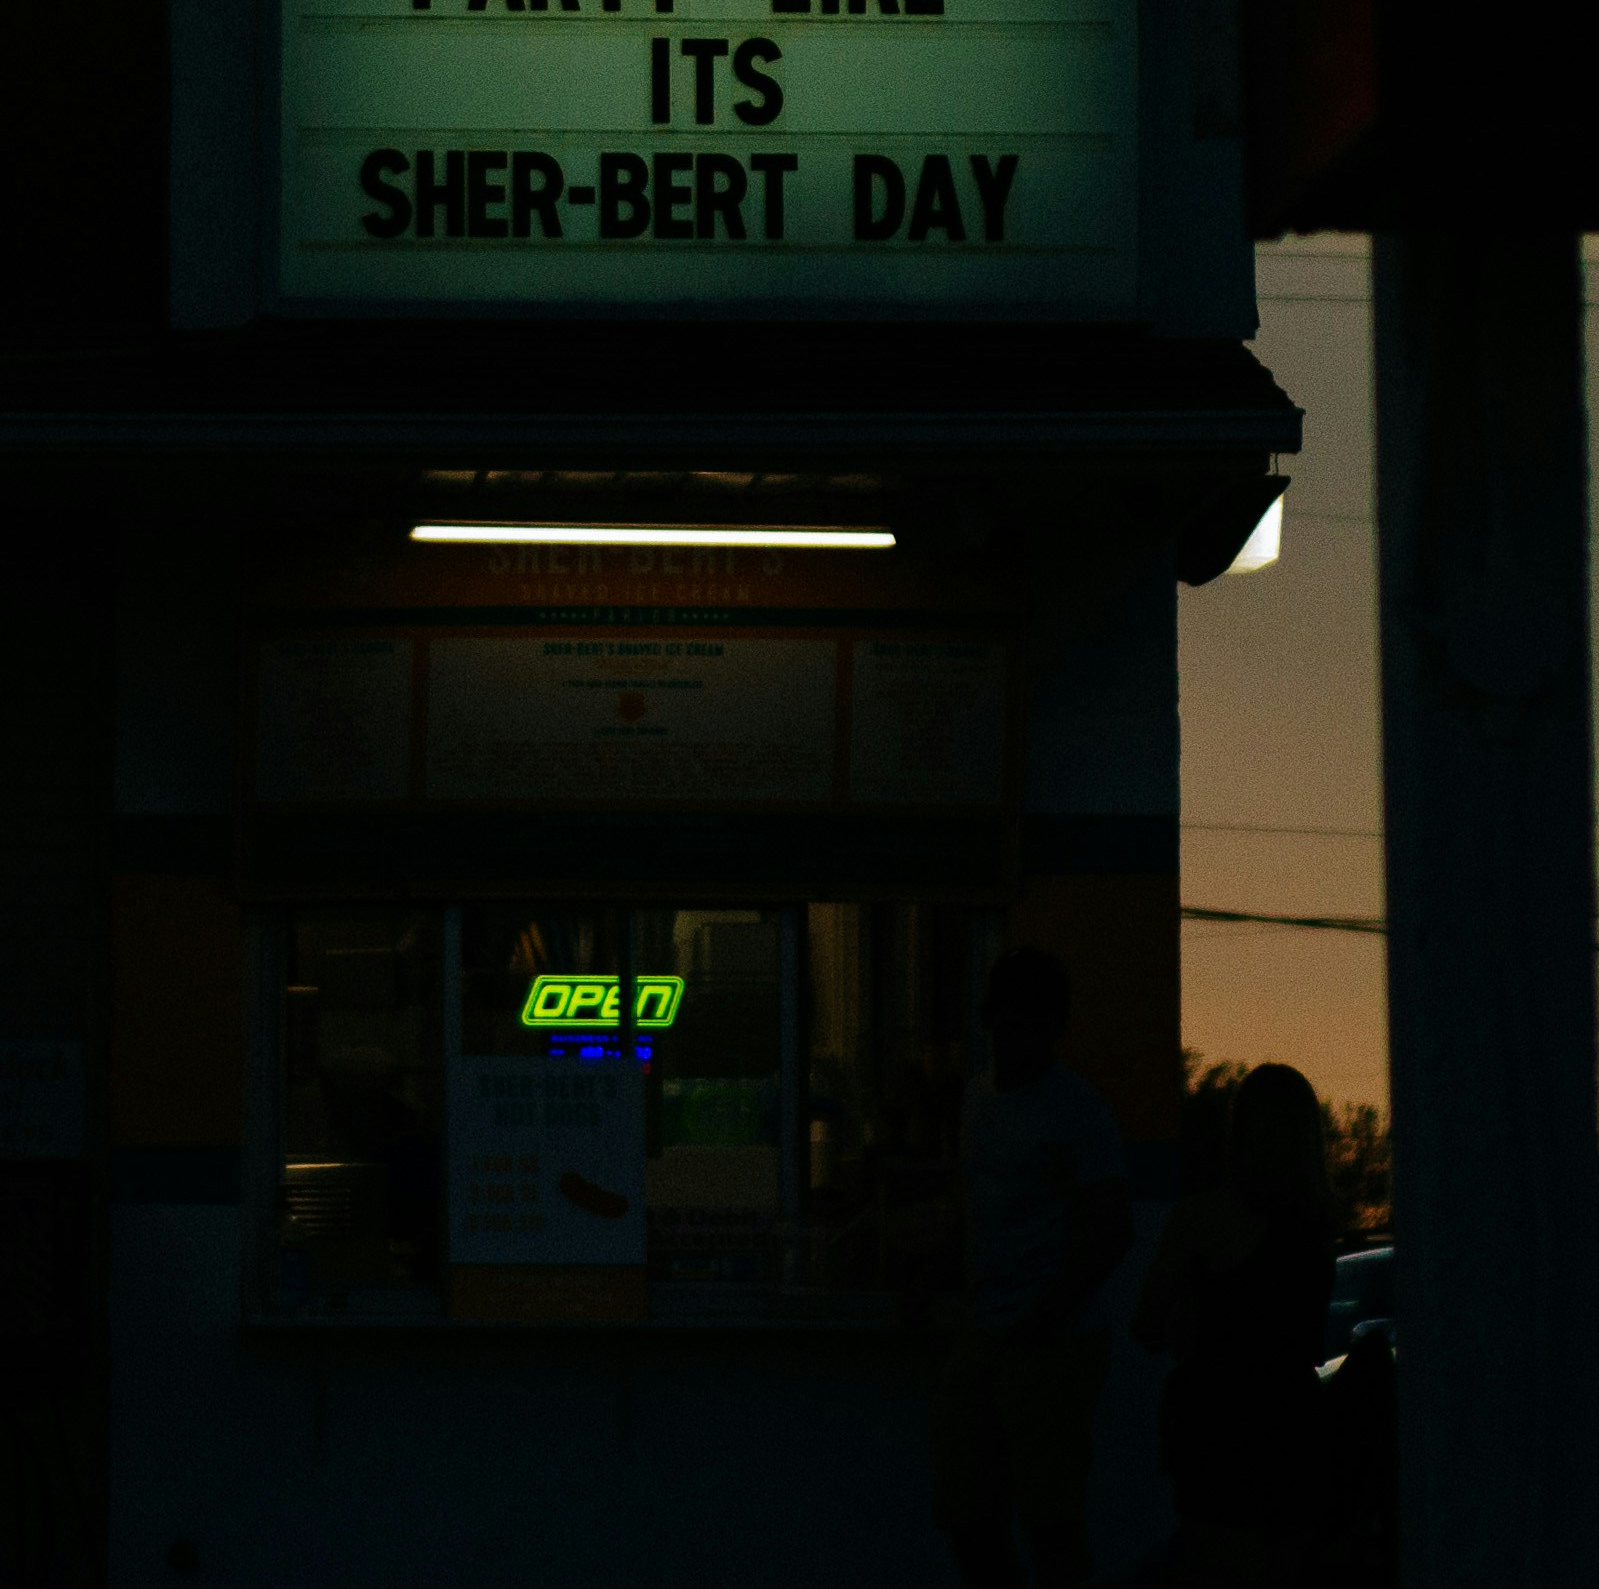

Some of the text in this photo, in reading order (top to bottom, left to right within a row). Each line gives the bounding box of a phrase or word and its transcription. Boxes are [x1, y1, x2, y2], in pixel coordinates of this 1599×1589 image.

[651, 36, 784, 126] ITS
[359, 148, 1020, 242] SHER-BERT DAY
[532, 984, 673, 1018] OPEN
